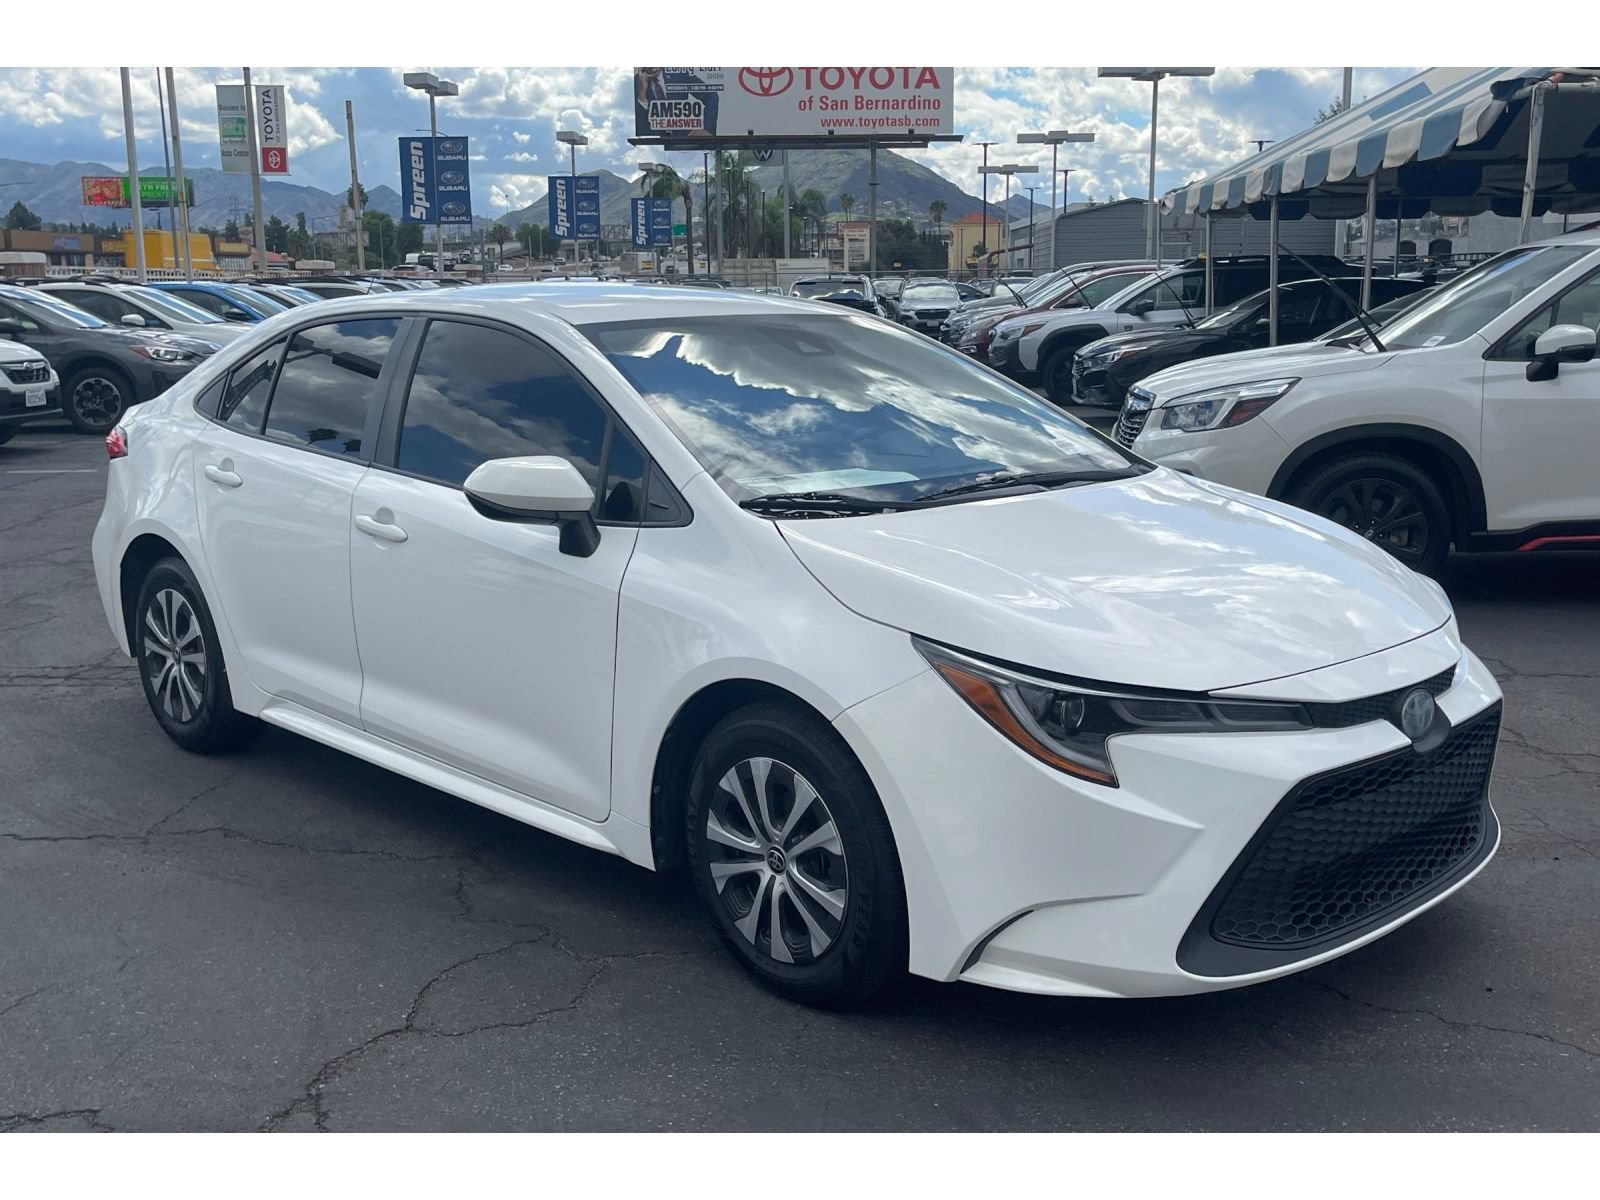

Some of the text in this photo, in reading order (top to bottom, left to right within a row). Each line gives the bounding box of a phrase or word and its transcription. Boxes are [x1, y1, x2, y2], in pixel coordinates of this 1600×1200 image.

[799, 67, 940, 90] TOYOTA
[650, 102, 702, 118] AM590
[798, 95, 941, 111] of San Bernardino
[262, 89, 274, 143] TOYOTA
[650, 119, 702, 128] THE ANSWER
[820, 115, 940, 129] www.toyotasb.com
[410, 141, 430, 220] Spreen
[555, 180, 570, 237] Spreen
[636, 200, 648, 246] Spreen
